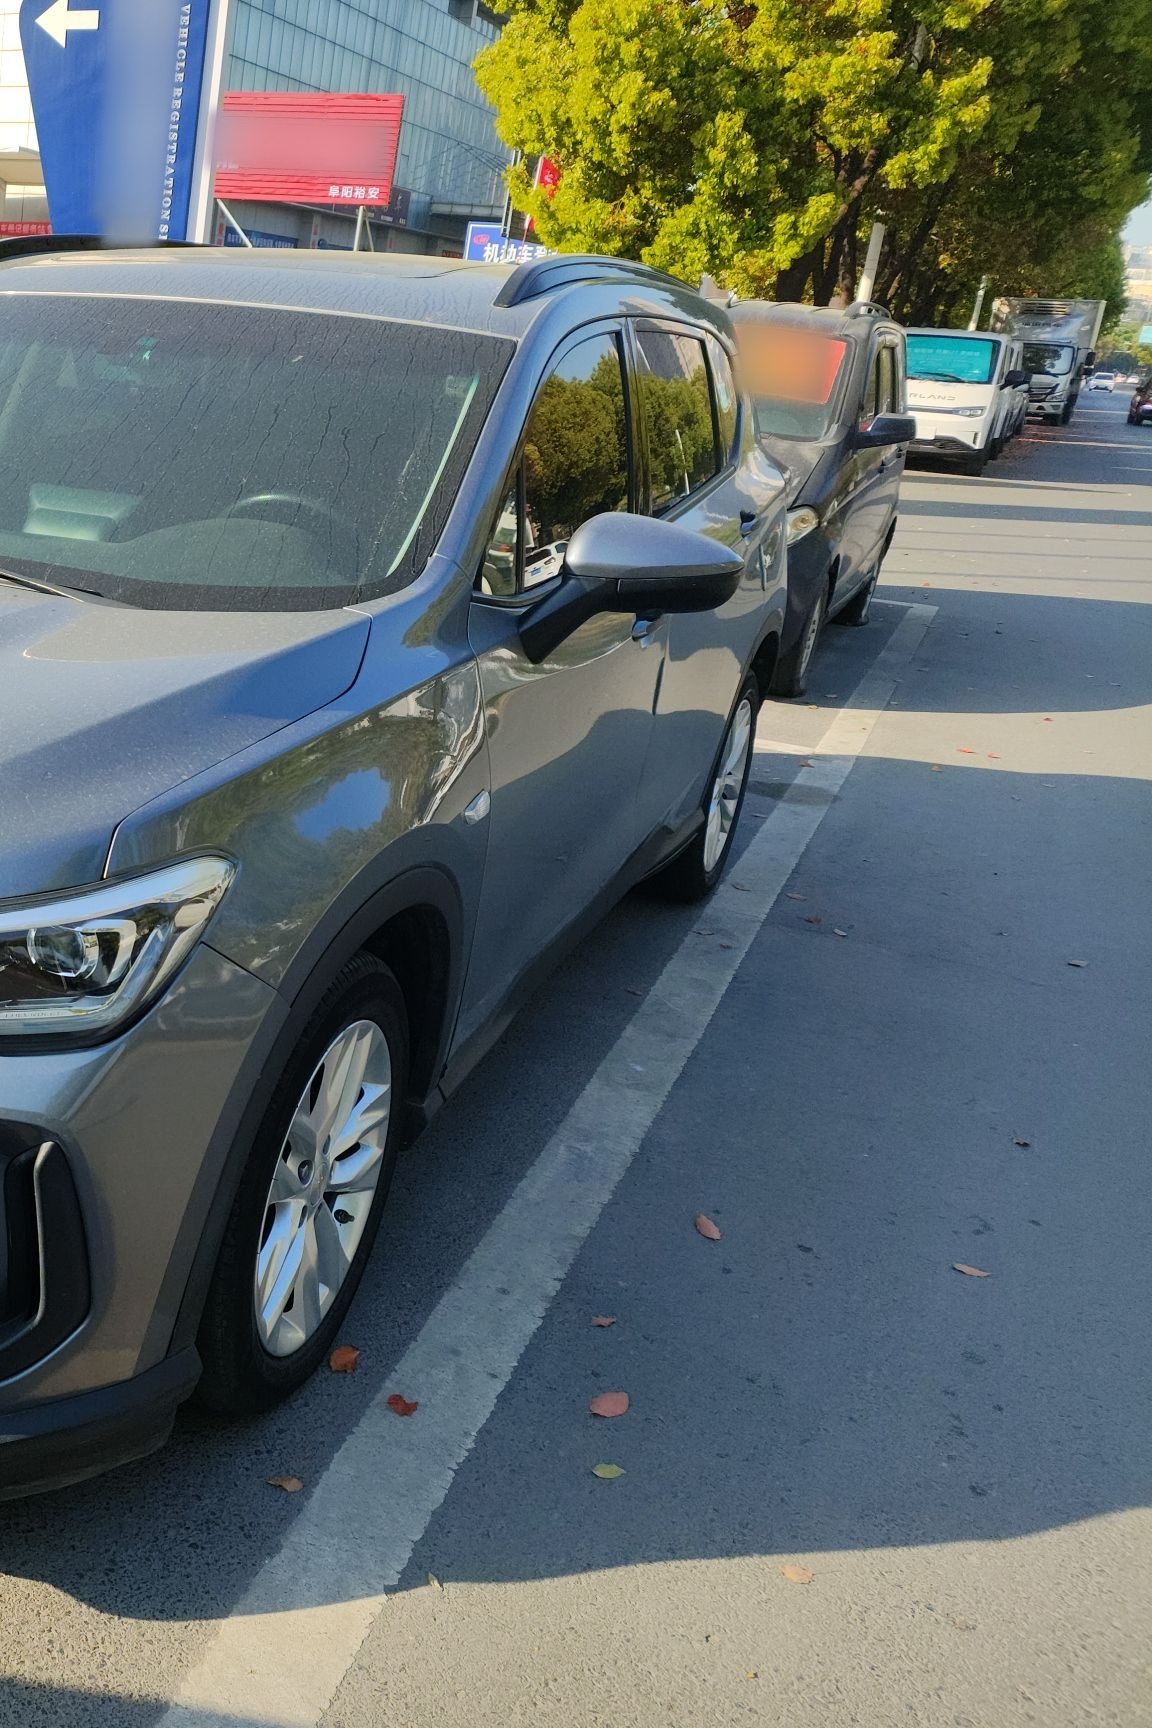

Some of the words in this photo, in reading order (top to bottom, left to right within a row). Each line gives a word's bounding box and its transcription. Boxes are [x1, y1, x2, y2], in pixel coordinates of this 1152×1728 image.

[174, 3, 191, 82] VEHICLE
[161, 86, 183, 221] REGISTRATION
[328, 185, 380, 200] 阜阳裕安
[483, 242, 558, 263] 机动车登
